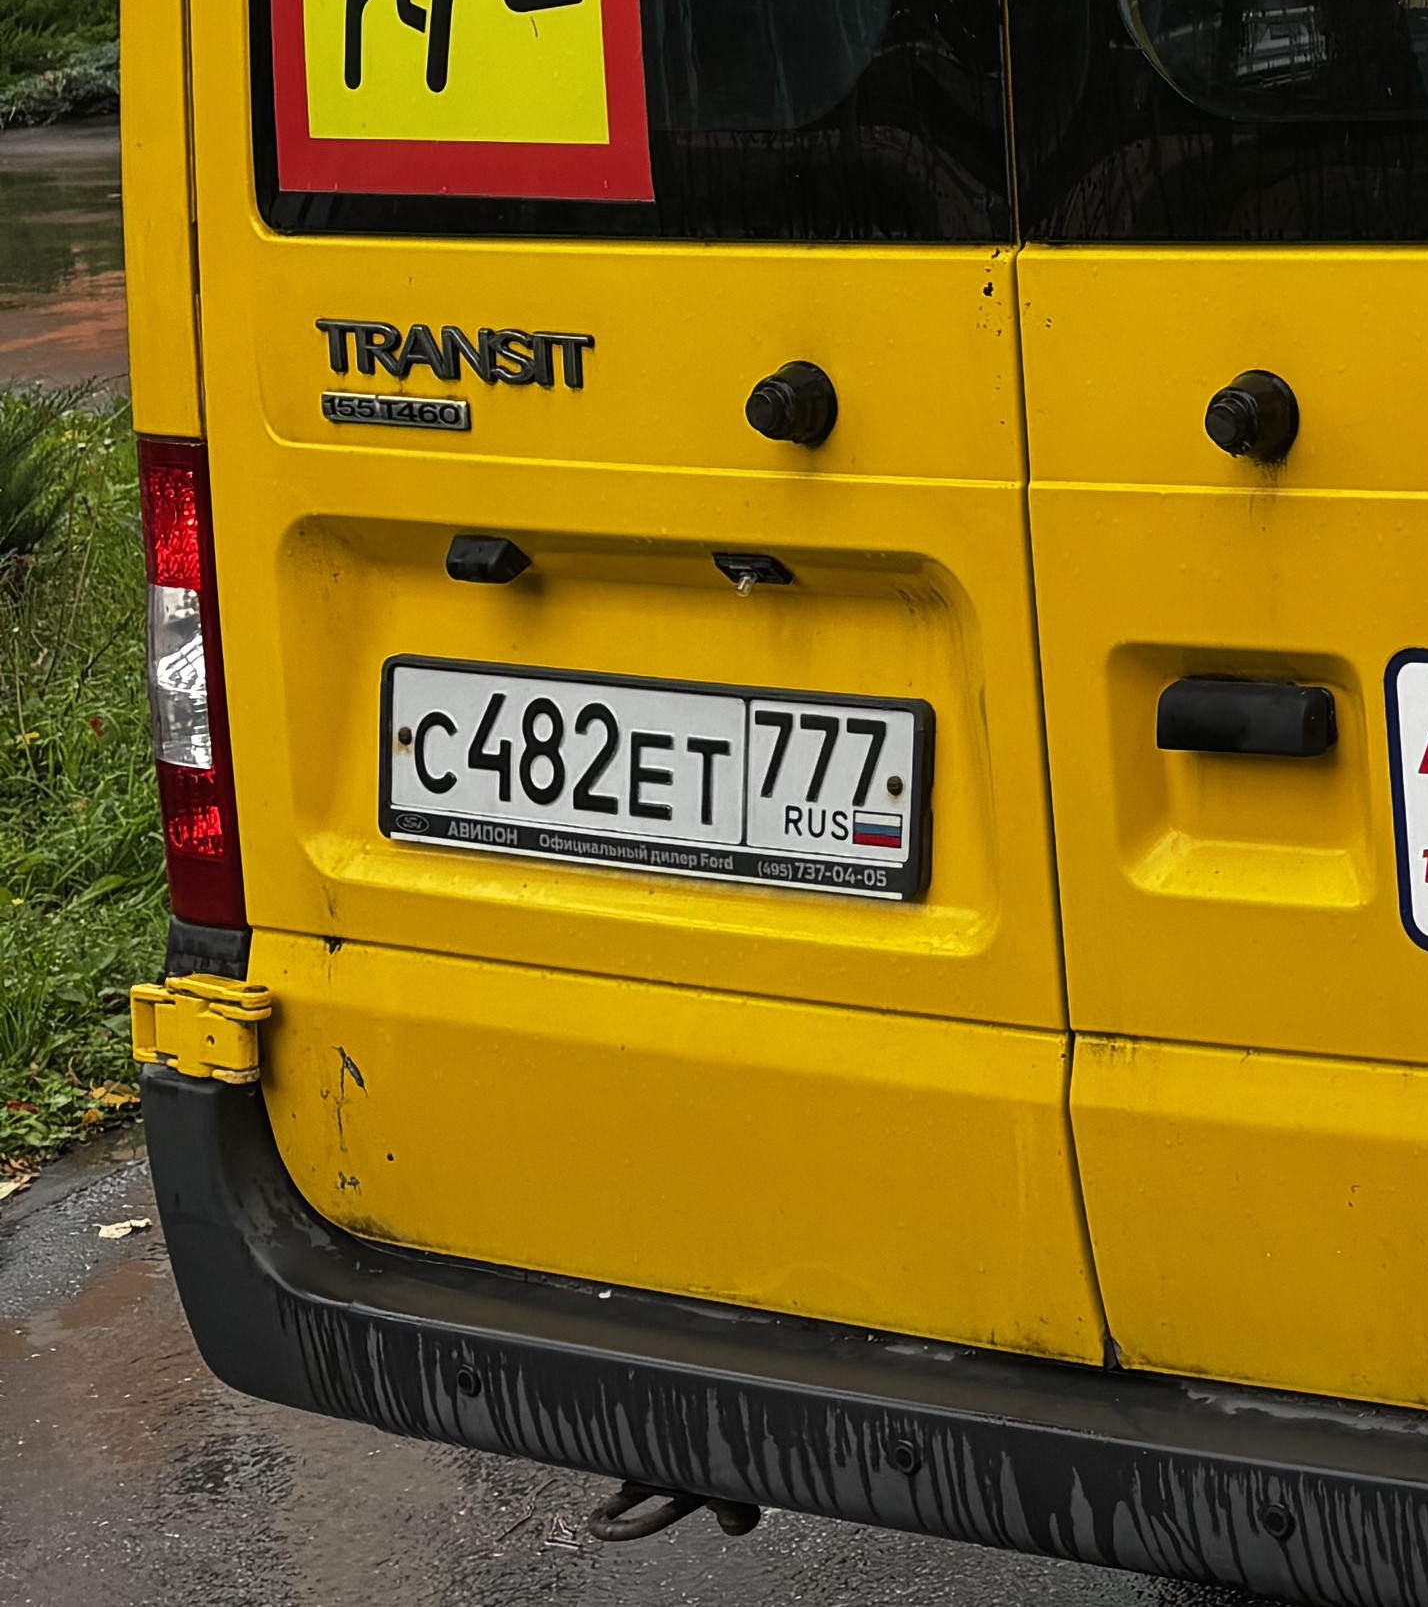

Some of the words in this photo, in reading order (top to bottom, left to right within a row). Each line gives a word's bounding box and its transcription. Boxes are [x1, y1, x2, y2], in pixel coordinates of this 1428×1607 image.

[315, 318, 595, 390] TRANSIT
[754, 709, 888, 807] 777
[447, 820, 518, 846] АВИЛОН
[785, 805, 850, 842] RUS
[539, 833, 648, 861] Официальный
[650, 851, 698, 868] дилер
[700, 853, 734, 871] Ford
[795, 862, 888, 887] 737-04-05
